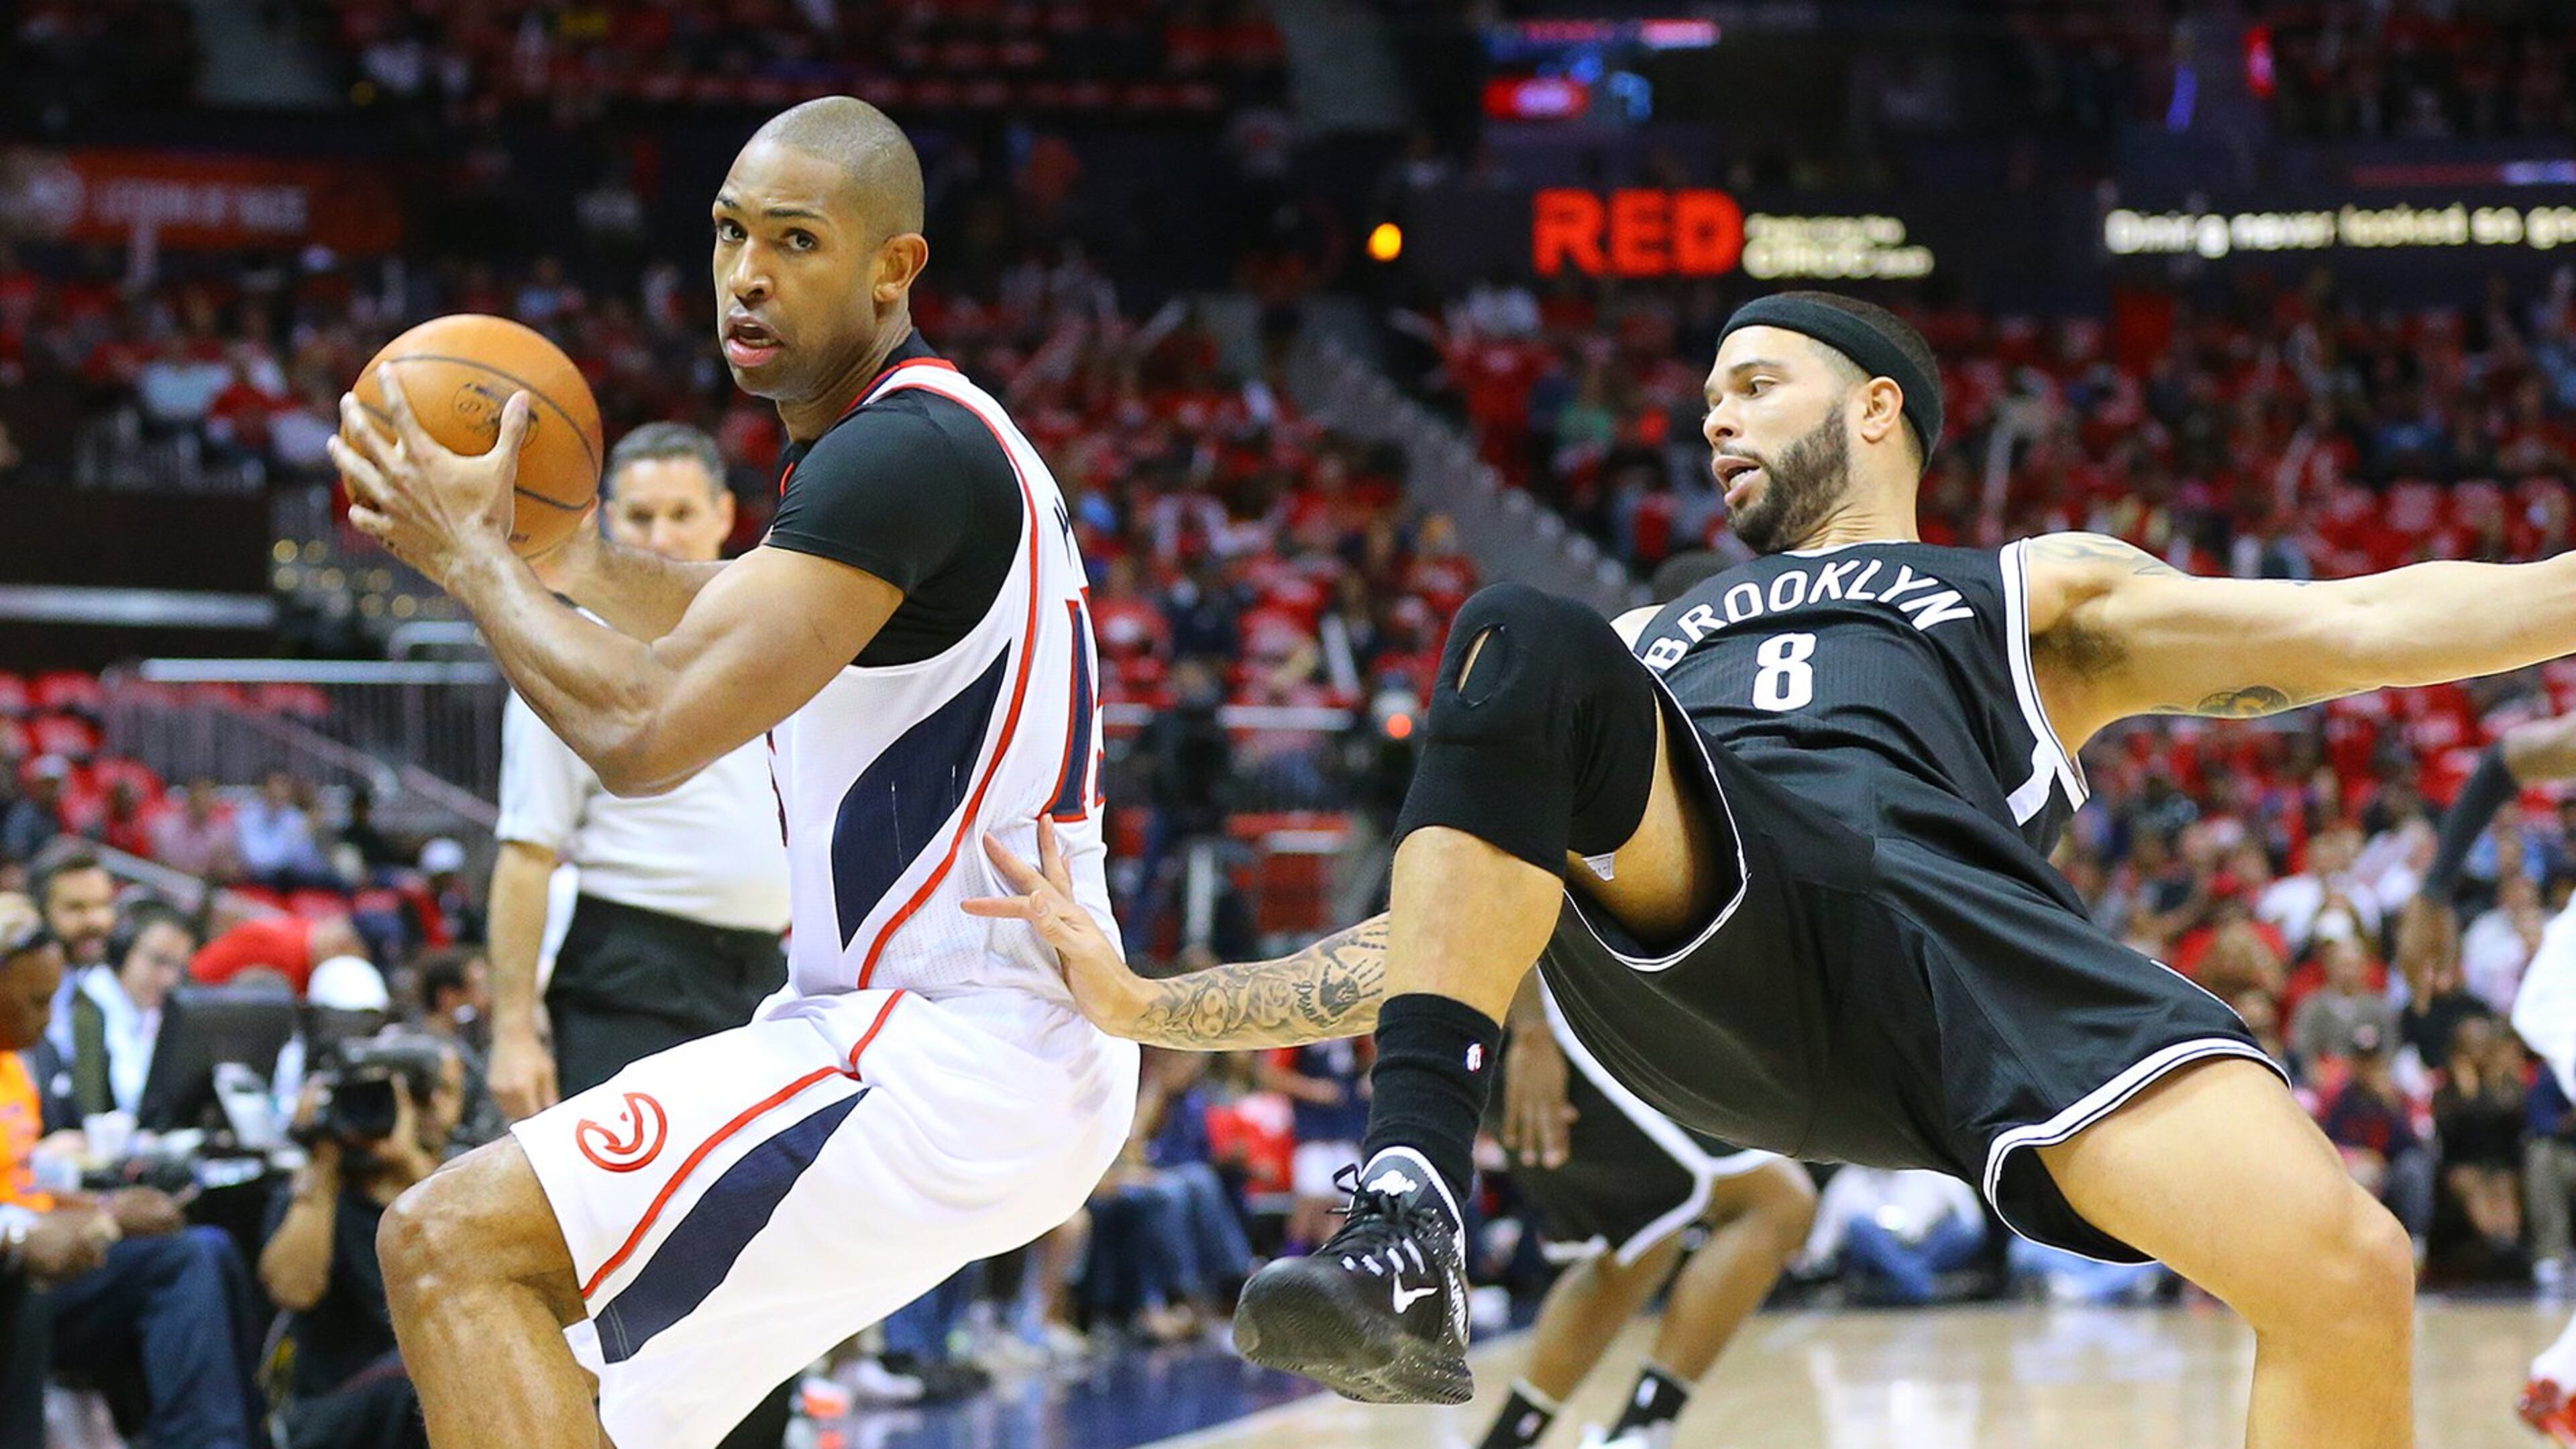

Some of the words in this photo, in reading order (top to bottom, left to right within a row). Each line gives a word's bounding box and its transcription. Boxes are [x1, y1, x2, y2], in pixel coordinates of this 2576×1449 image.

[1532, 187, 1744, 278] RED
[1643, 558, 1975, 670] BROOKLYN
[1752, 631, 1817, 712] 8
